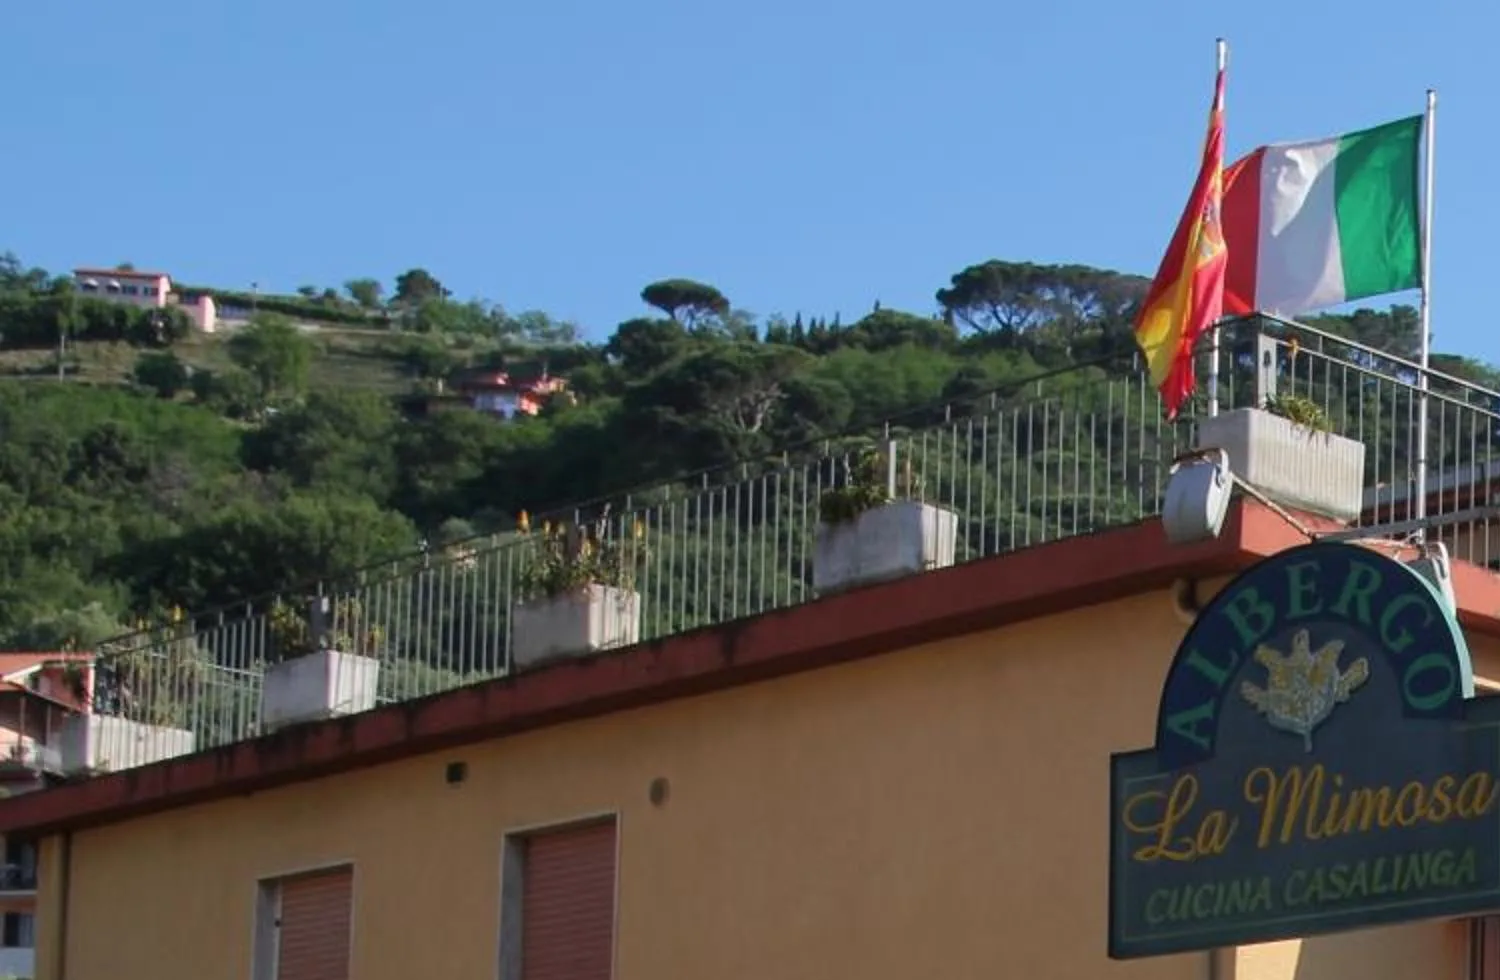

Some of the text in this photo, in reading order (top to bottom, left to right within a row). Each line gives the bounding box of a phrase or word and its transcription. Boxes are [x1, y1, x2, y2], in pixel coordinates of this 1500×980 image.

[1167, 561, 1455, 750] ALBERGO
[1122, 763, 1500, 862] La Mimosa
[1145, 848, 1477, 924] CUCINA CASALINGA
